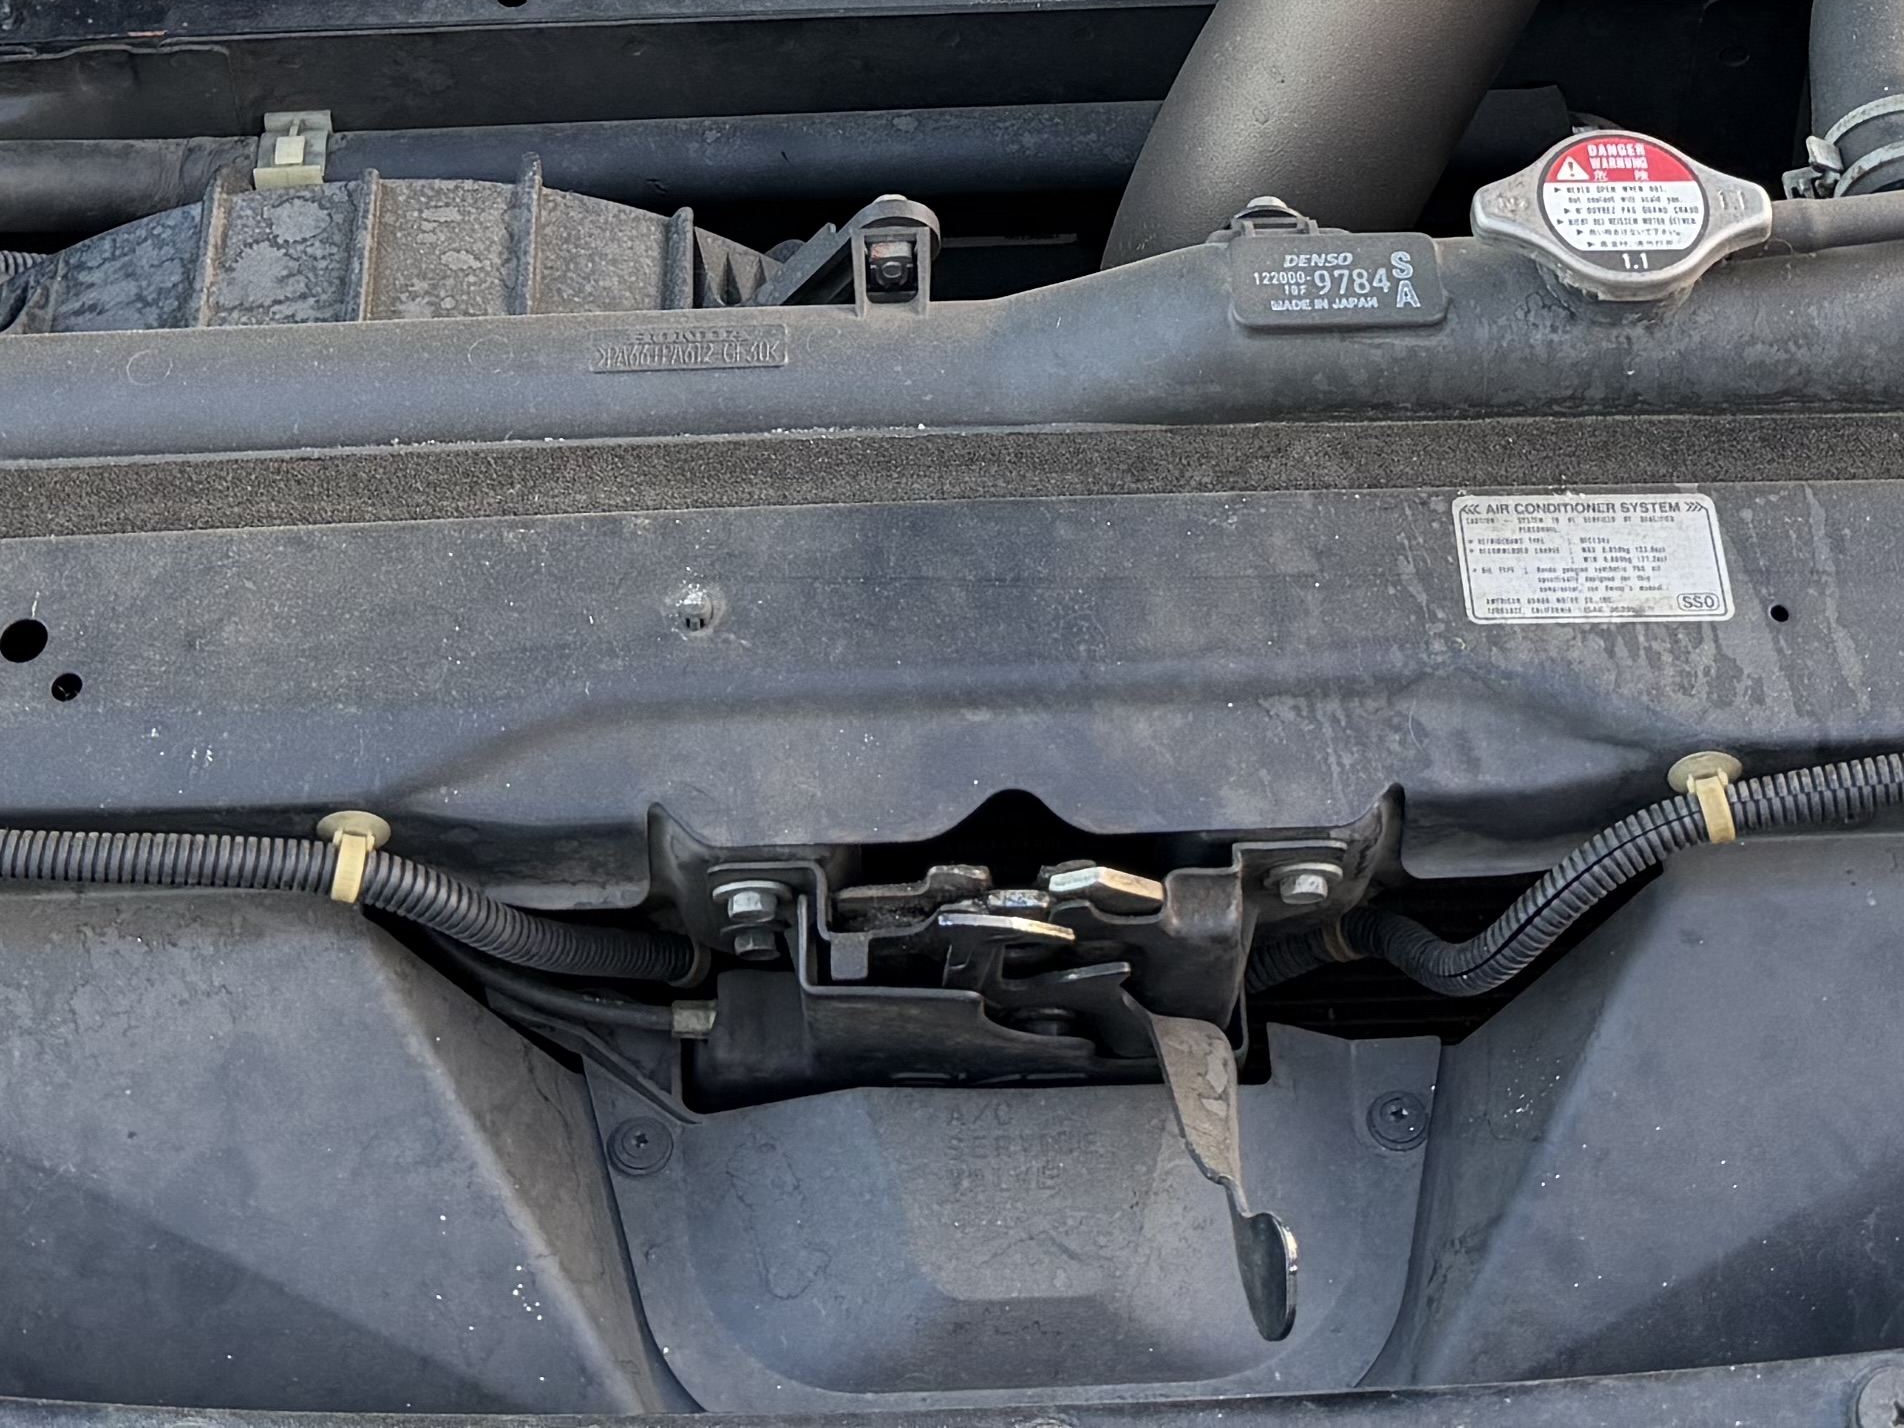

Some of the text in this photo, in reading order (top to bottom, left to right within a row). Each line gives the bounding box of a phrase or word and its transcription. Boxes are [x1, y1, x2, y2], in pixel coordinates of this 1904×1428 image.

[1587, 144, 1646, 158] DANGER
[1283, 252, 1353, 268] DENSO
[1621, 253, 1648, 270] 1.1
[1271, 296, 1379, 311] MADE IN JAPAN
[1486, 501, 1681, 516] AIR CONDITIONER SYSTEM
